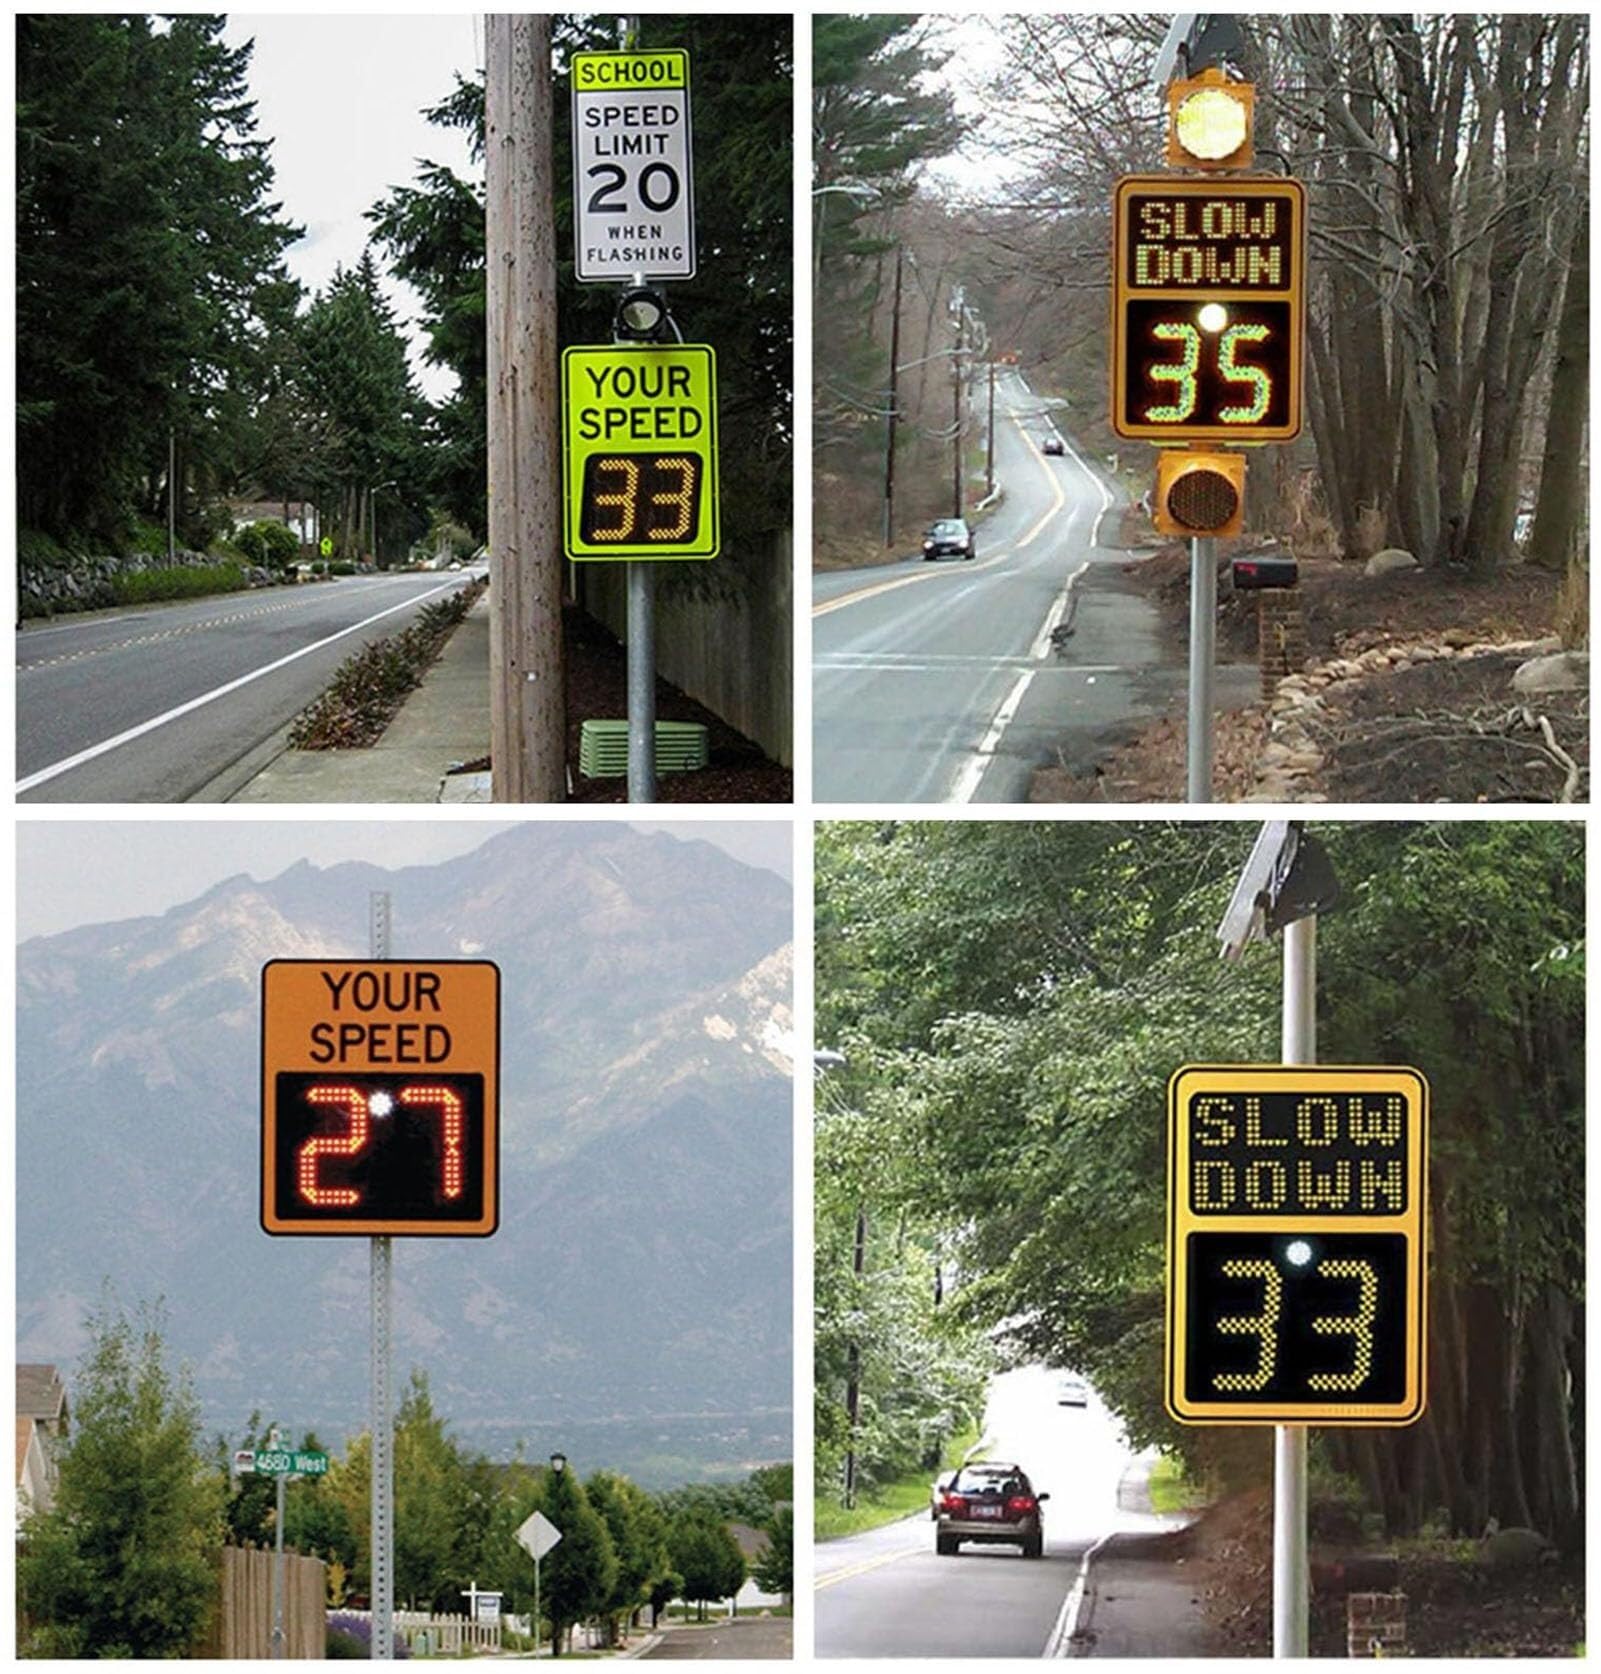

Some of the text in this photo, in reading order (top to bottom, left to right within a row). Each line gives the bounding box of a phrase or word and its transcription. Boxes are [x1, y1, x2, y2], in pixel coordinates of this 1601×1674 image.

[581, 61, 681, 83] SCHOOL
[585, 106, 679, 127] SPEED
[595, 134, 669, 155] LIMIT
[587, 162, 680, 213] 20
[608, 226, 662, 239] WHEN
[1141, 203, 1276, 240] SLOW
[587, 247, 683, 262] FLASHING
[1136, 245, 1281, 285] DOWN
[585, 366, 691, 398] YOUR
[1145, 323, 1271, 423] 35
[579, 407, 702, 440] SPEED
[592, 459, 694, 540] 33
[321, 971, 441, 1011] YOUR
[309, 1023, 452, 1063] SPEED
[1195, 1098, 1401, 1146] SLOW
[300, 1087, 460, 1204] 27
[1195, 1161, 1401, 1209] DOWN
[1212, 1260, 1378, 1390] 33
[295, 1455, 326, 1472] West
